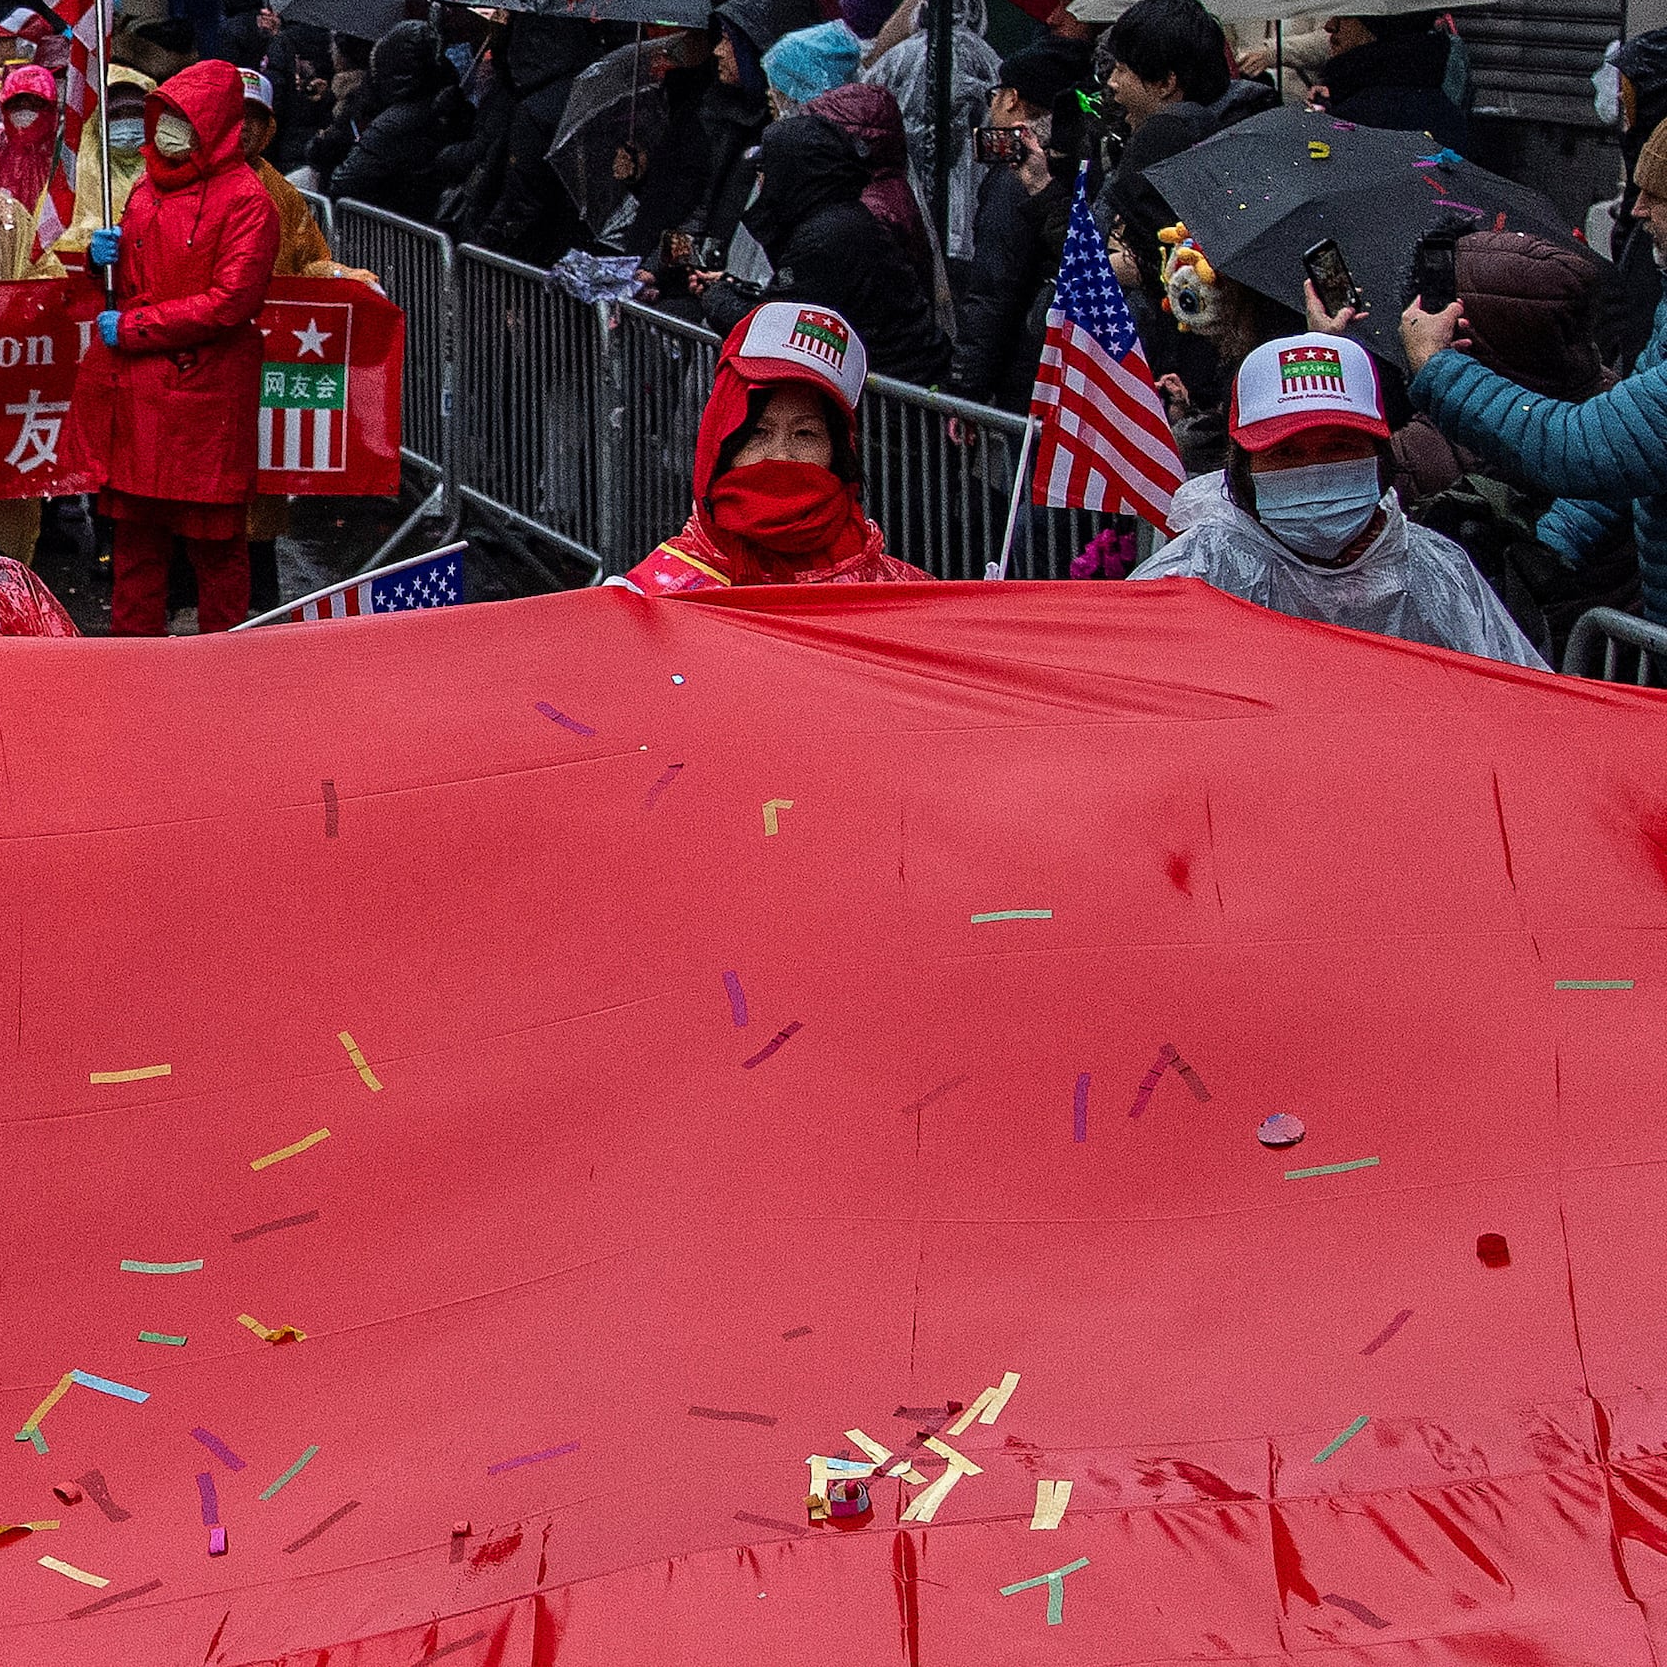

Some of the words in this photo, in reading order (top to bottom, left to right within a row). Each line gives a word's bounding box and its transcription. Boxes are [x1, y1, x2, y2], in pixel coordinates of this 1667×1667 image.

[263, 371, 339, 400] 网友会
[1277, 393, 1304, 404] Chinese
[1305, 392, 1341, 401] Association
